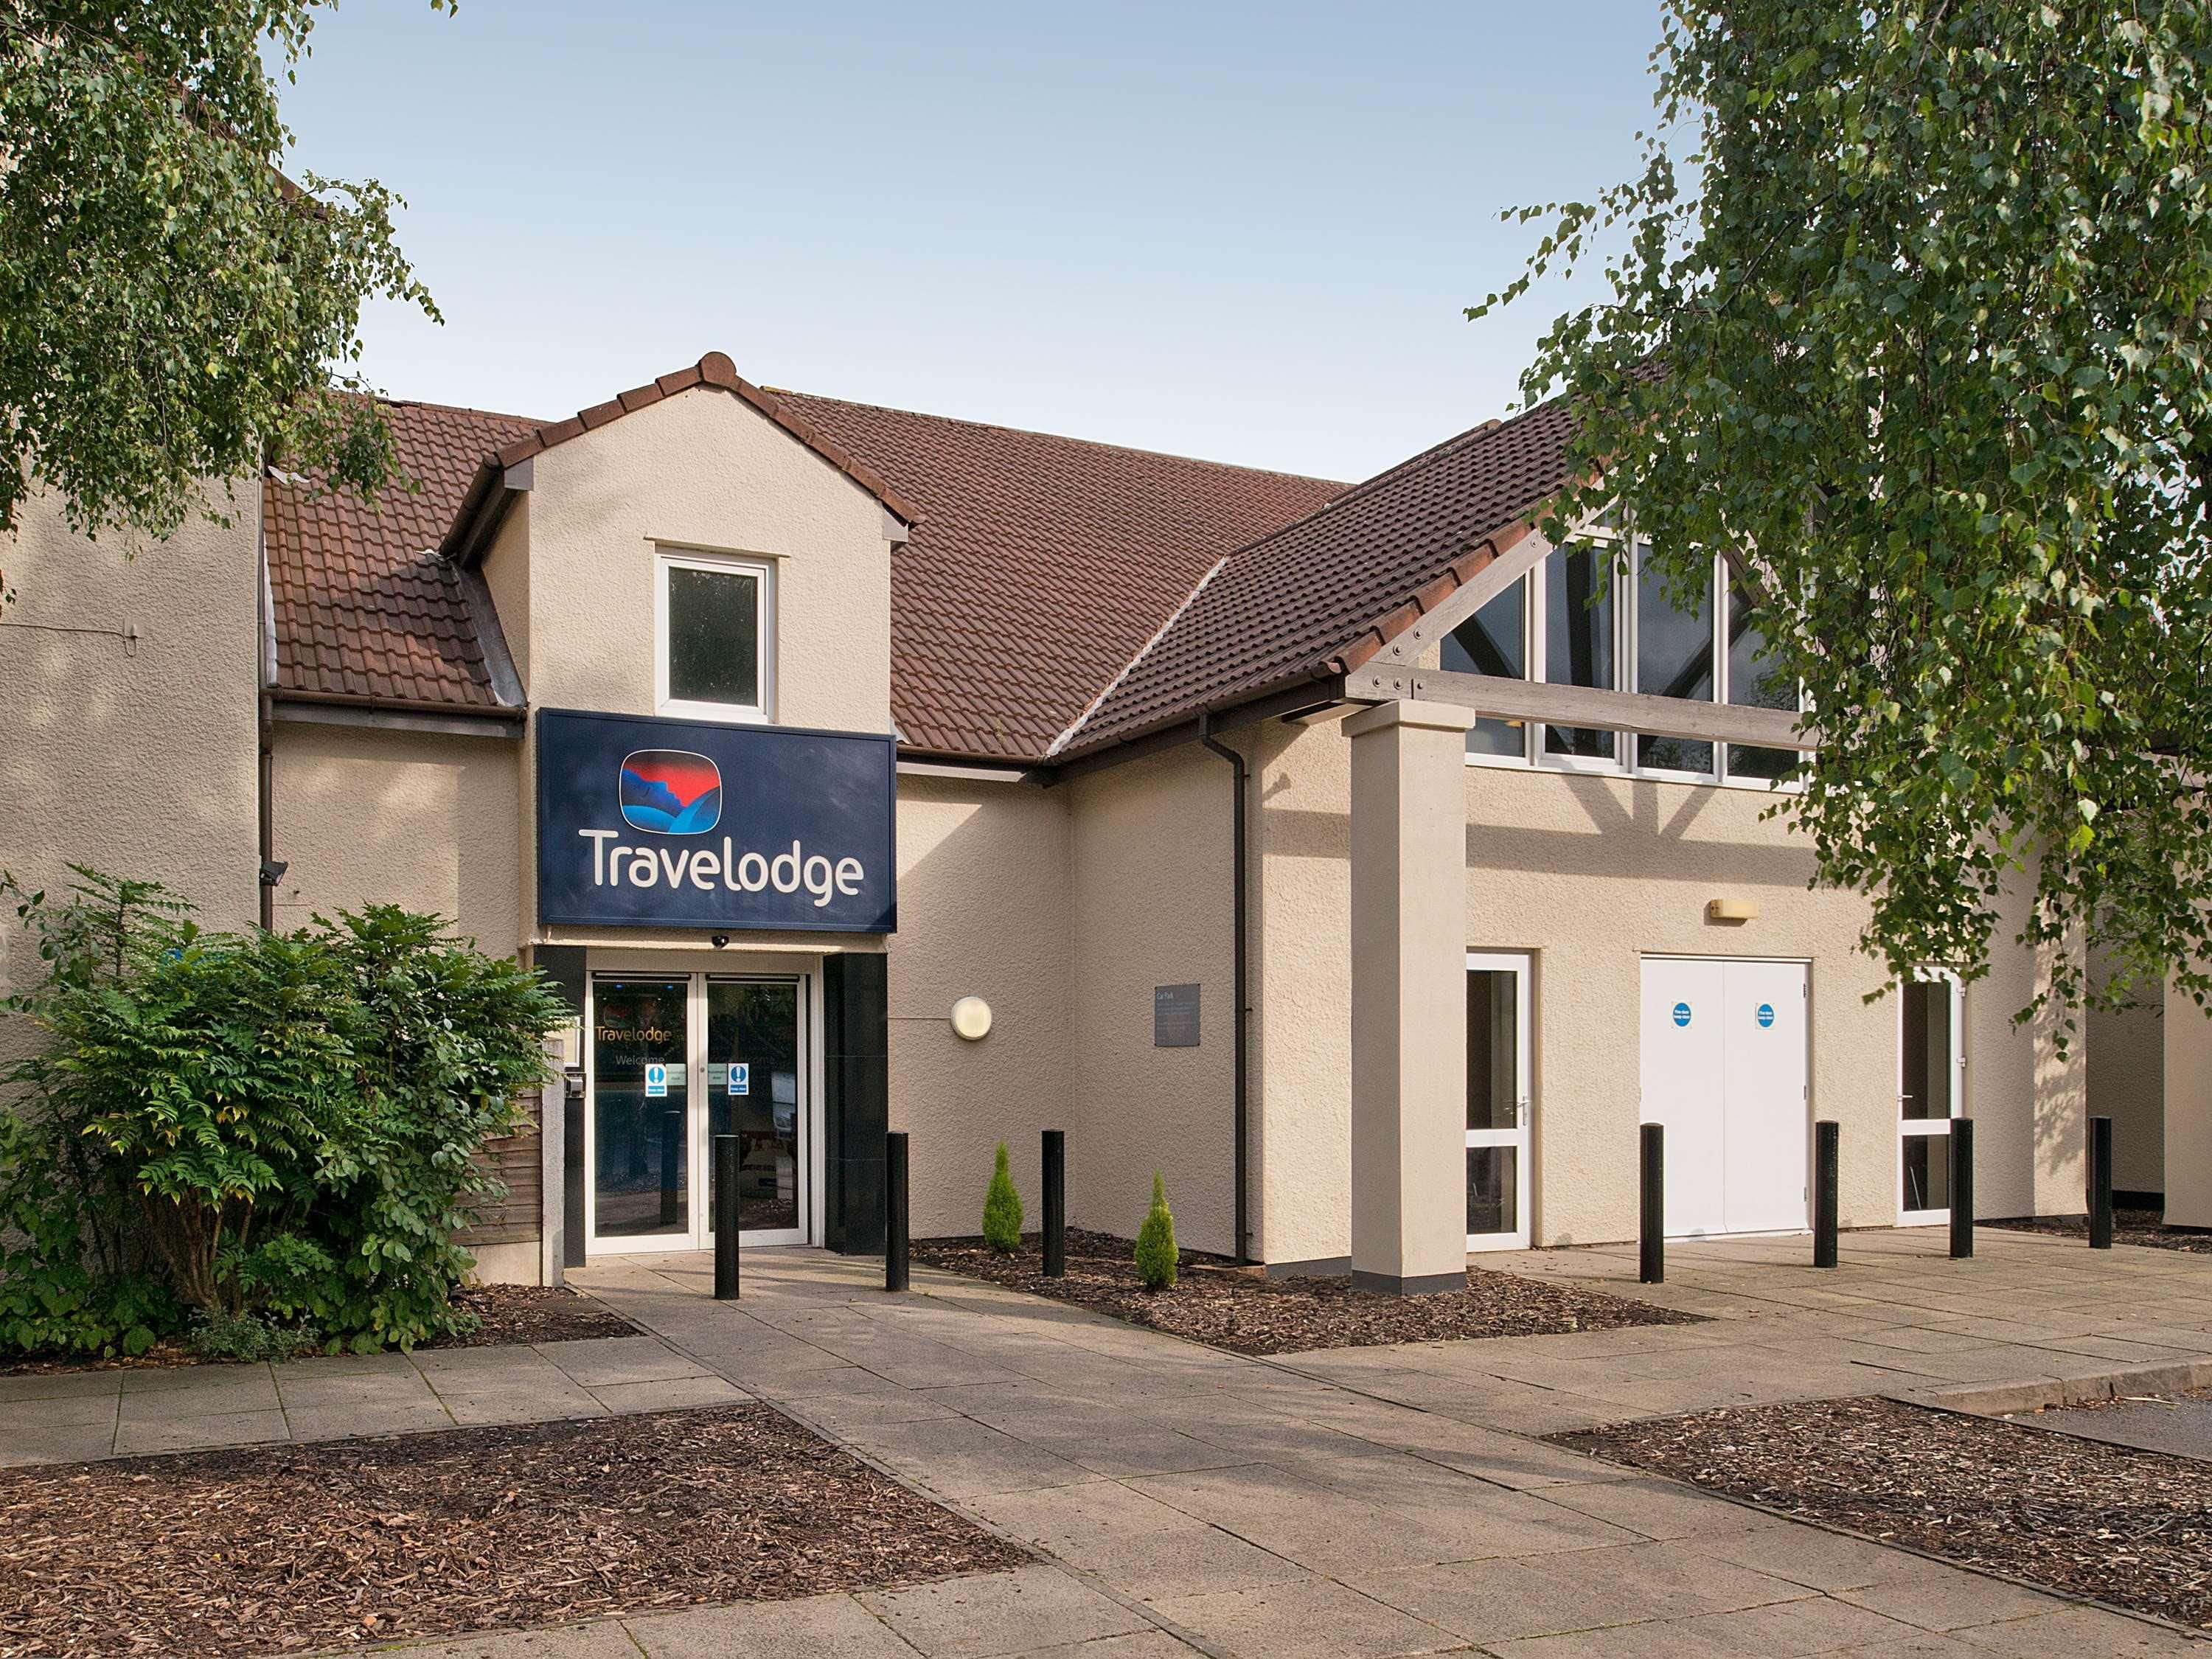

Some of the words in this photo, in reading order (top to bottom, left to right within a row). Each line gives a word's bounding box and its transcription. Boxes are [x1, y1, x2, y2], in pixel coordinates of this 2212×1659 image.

[578, 829, 864, 908] Travelodge
[595, 1026, 672, 1044] Travelodge
[615, 1055, 665, 1065] Welcome
